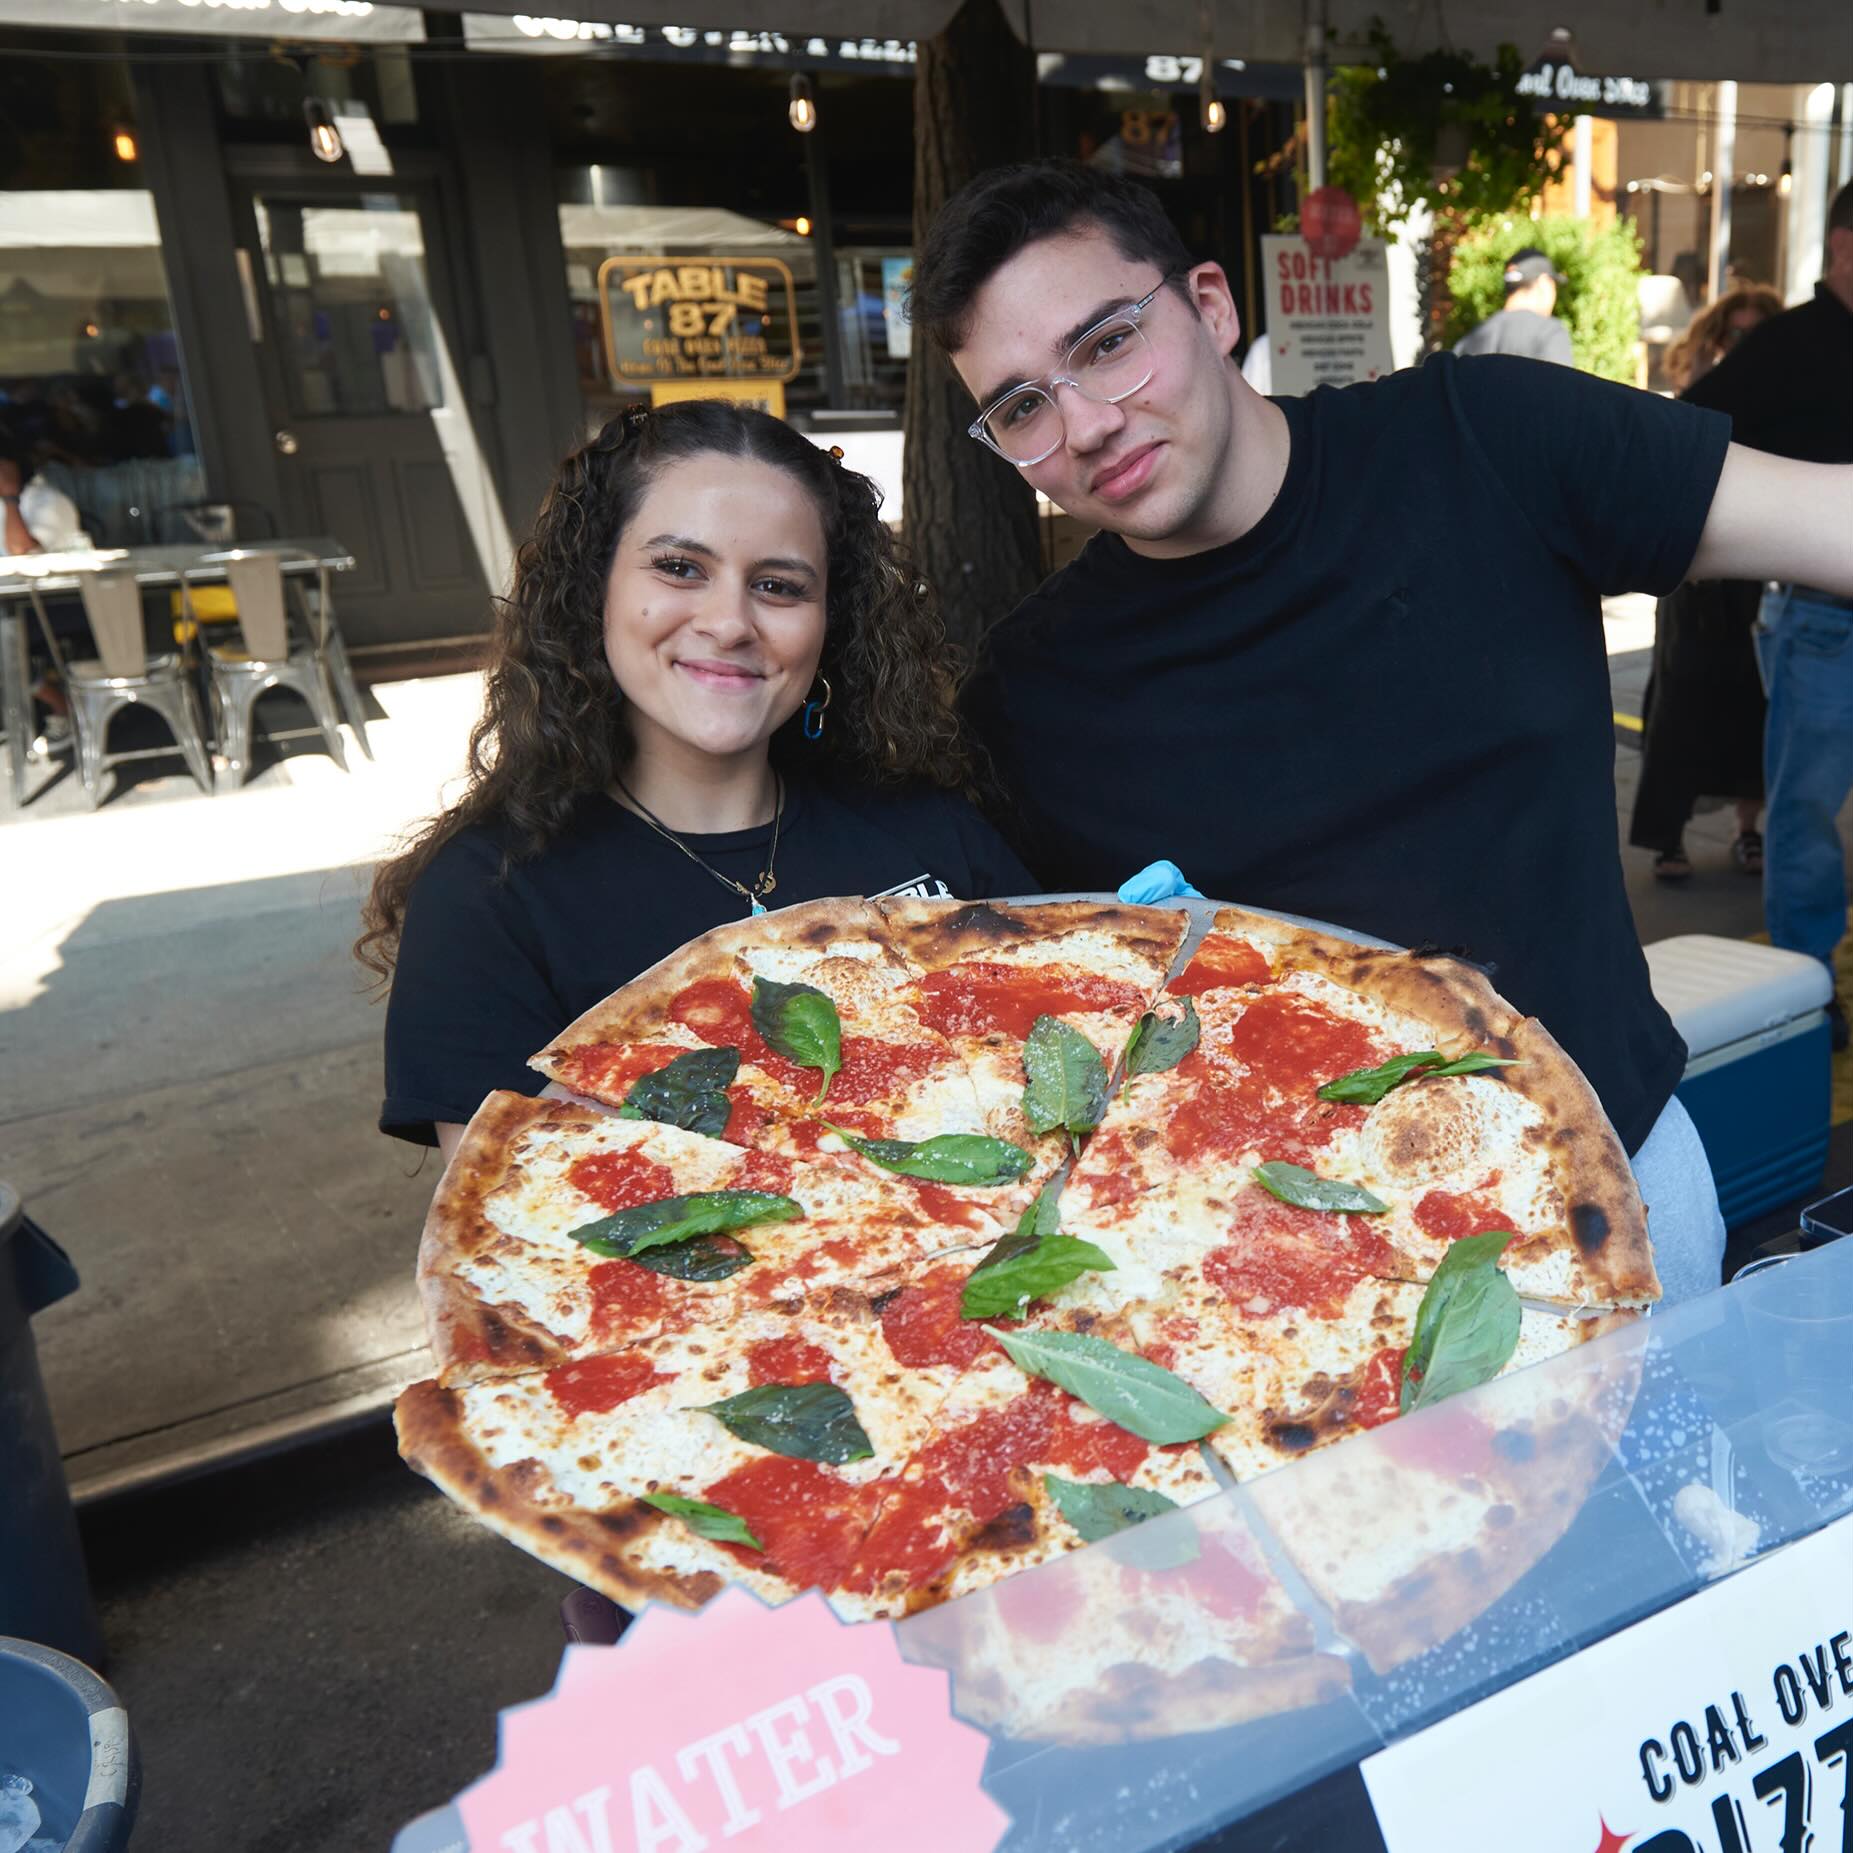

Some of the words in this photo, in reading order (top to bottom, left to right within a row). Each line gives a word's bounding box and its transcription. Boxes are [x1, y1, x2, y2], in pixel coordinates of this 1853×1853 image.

[1145, 55, 1204, 83] 87
[1277, 249, 1334, 281] SOFT
[622, 266, 769, 312] TABLE
[1279, 282, 1374, 315] DRINKS
[669, 301, 737, 337] 87
[500, 1672, 903, 1853] WATER
[1638, 1691, 1768, 1804] COAL
